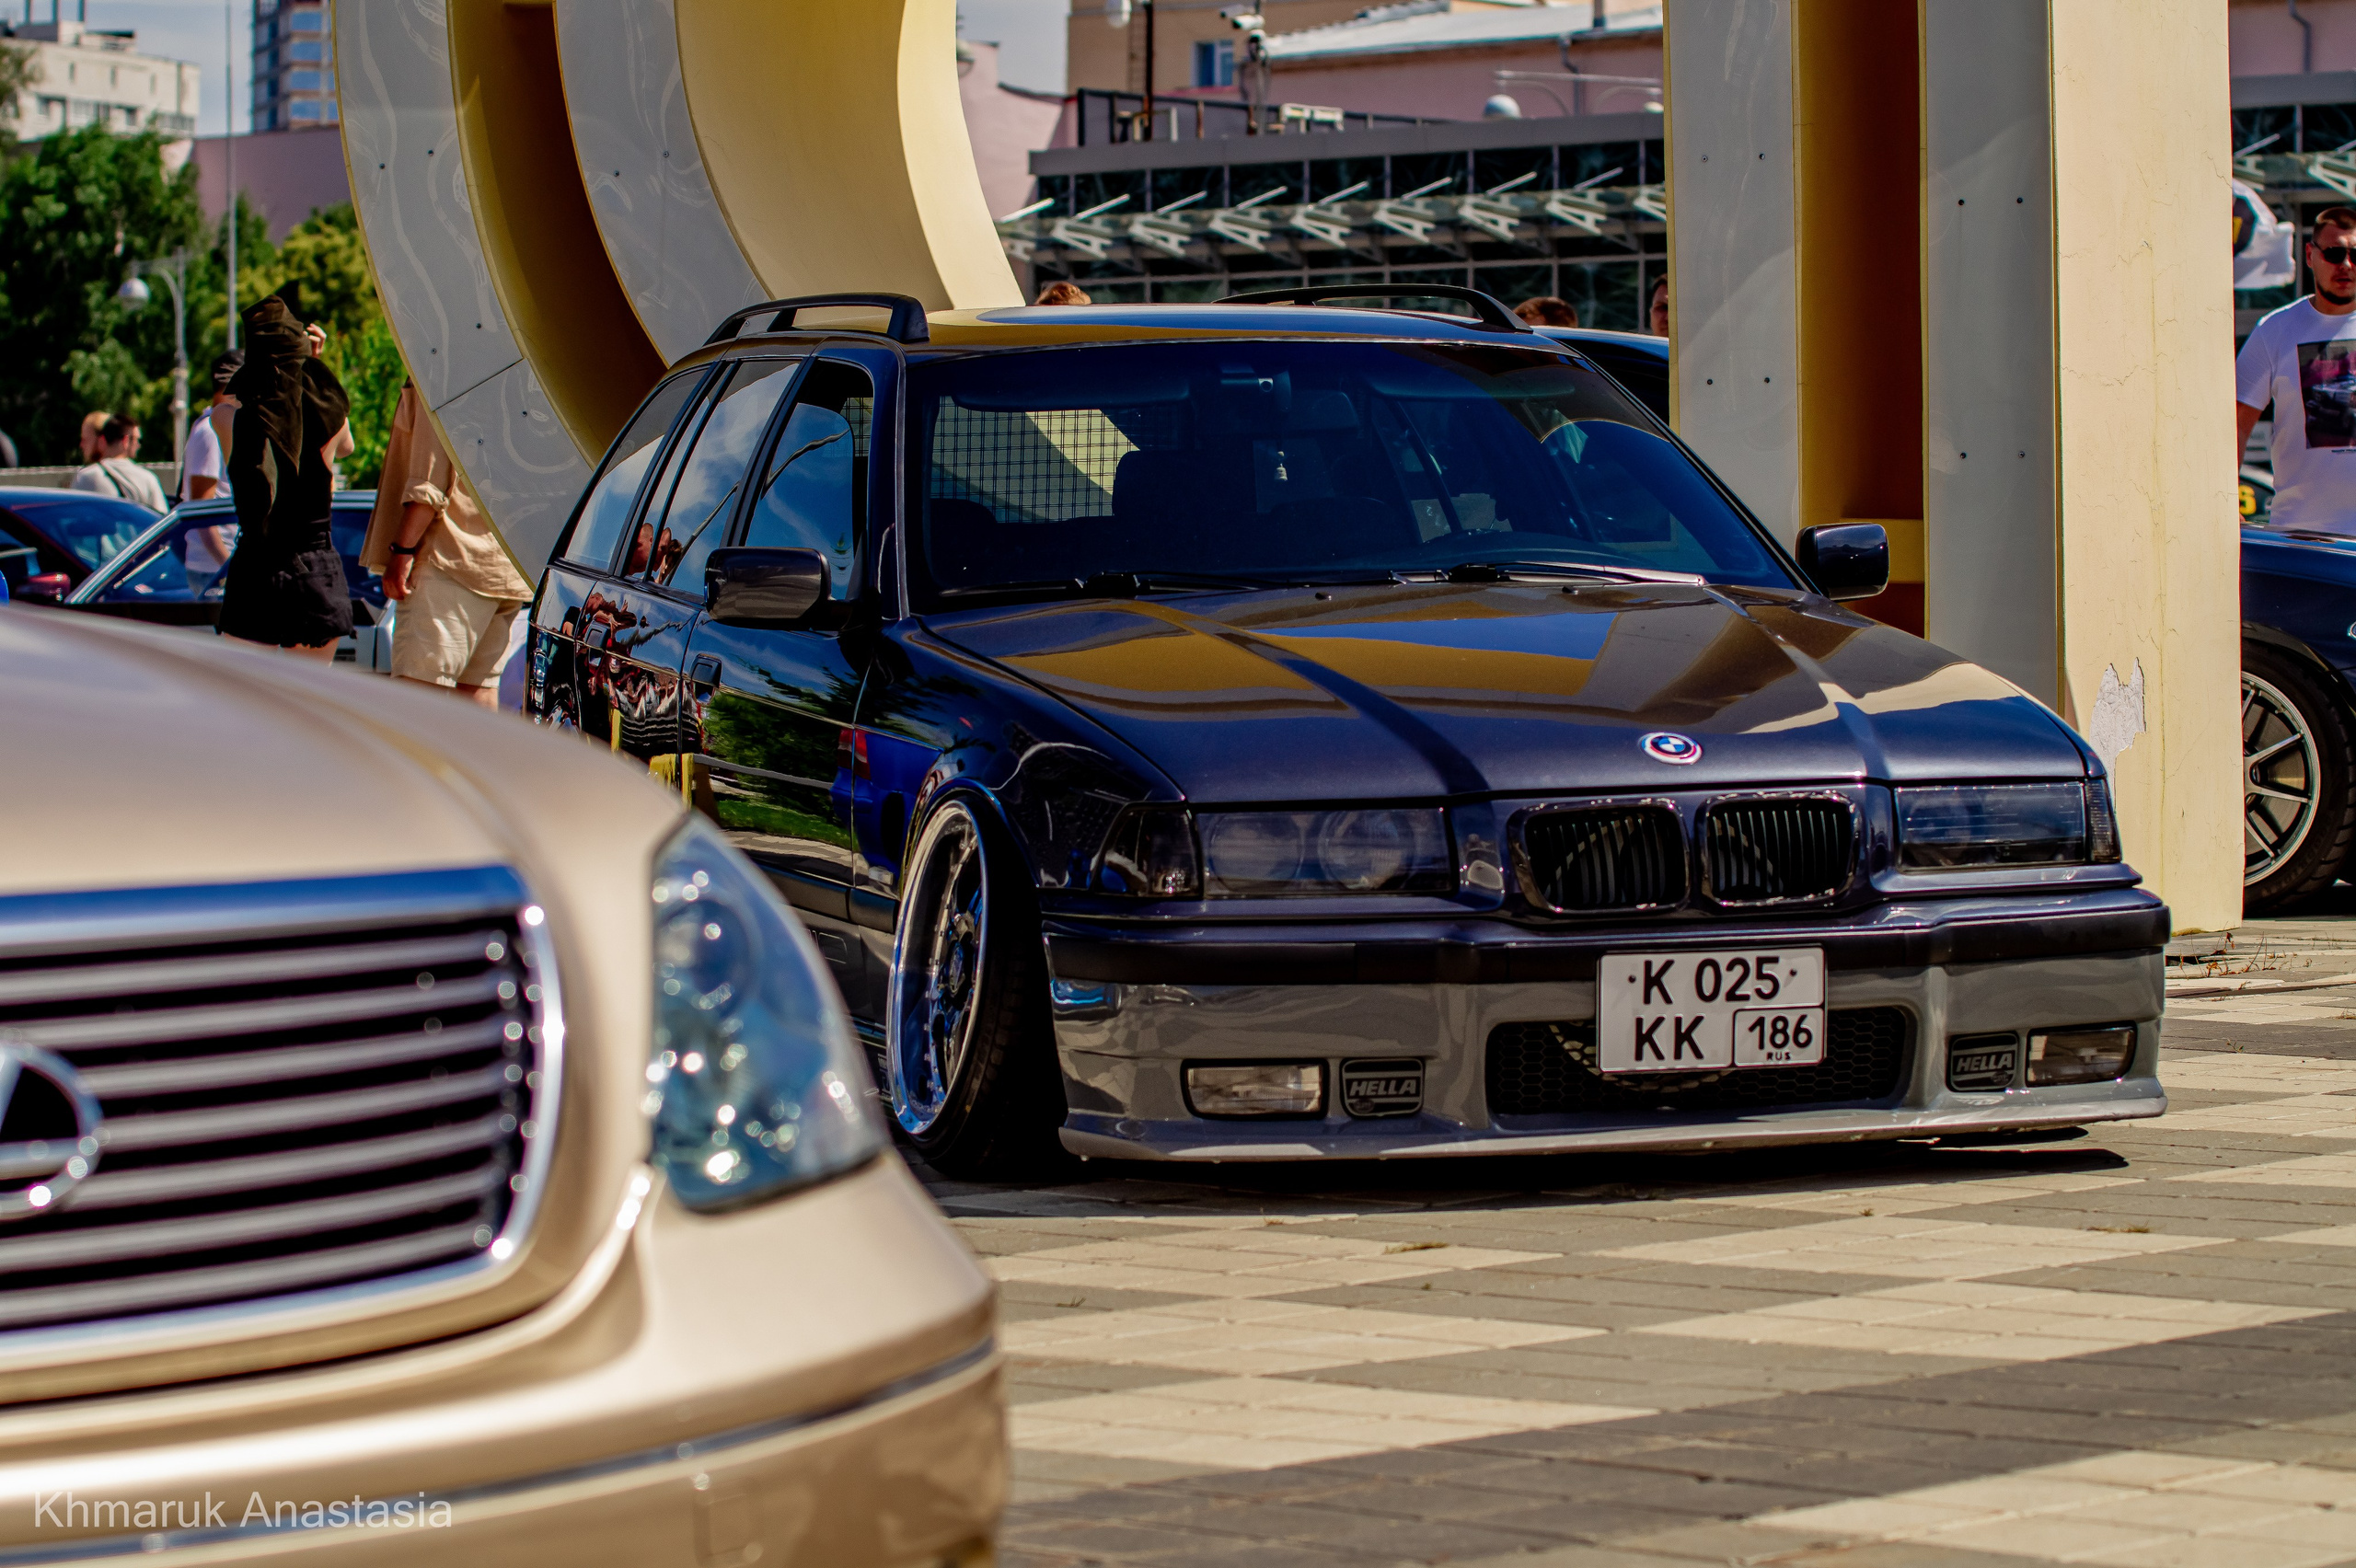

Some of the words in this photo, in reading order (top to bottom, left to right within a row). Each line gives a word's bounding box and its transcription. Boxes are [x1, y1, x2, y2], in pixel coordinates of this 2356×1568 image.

[1644, 960, 1675, 1005] K
[1694, 956, 1780, 1003] 025
[1634, 1015, 1704, 1061] KK
[1748, 1014, 1813, 1051] 186
[1766, 1051, 1792, 1061] RUS
[1956, 1053, 2013, 1072] HELLA
[1350, 1078, 1417, 1096] HELLA
